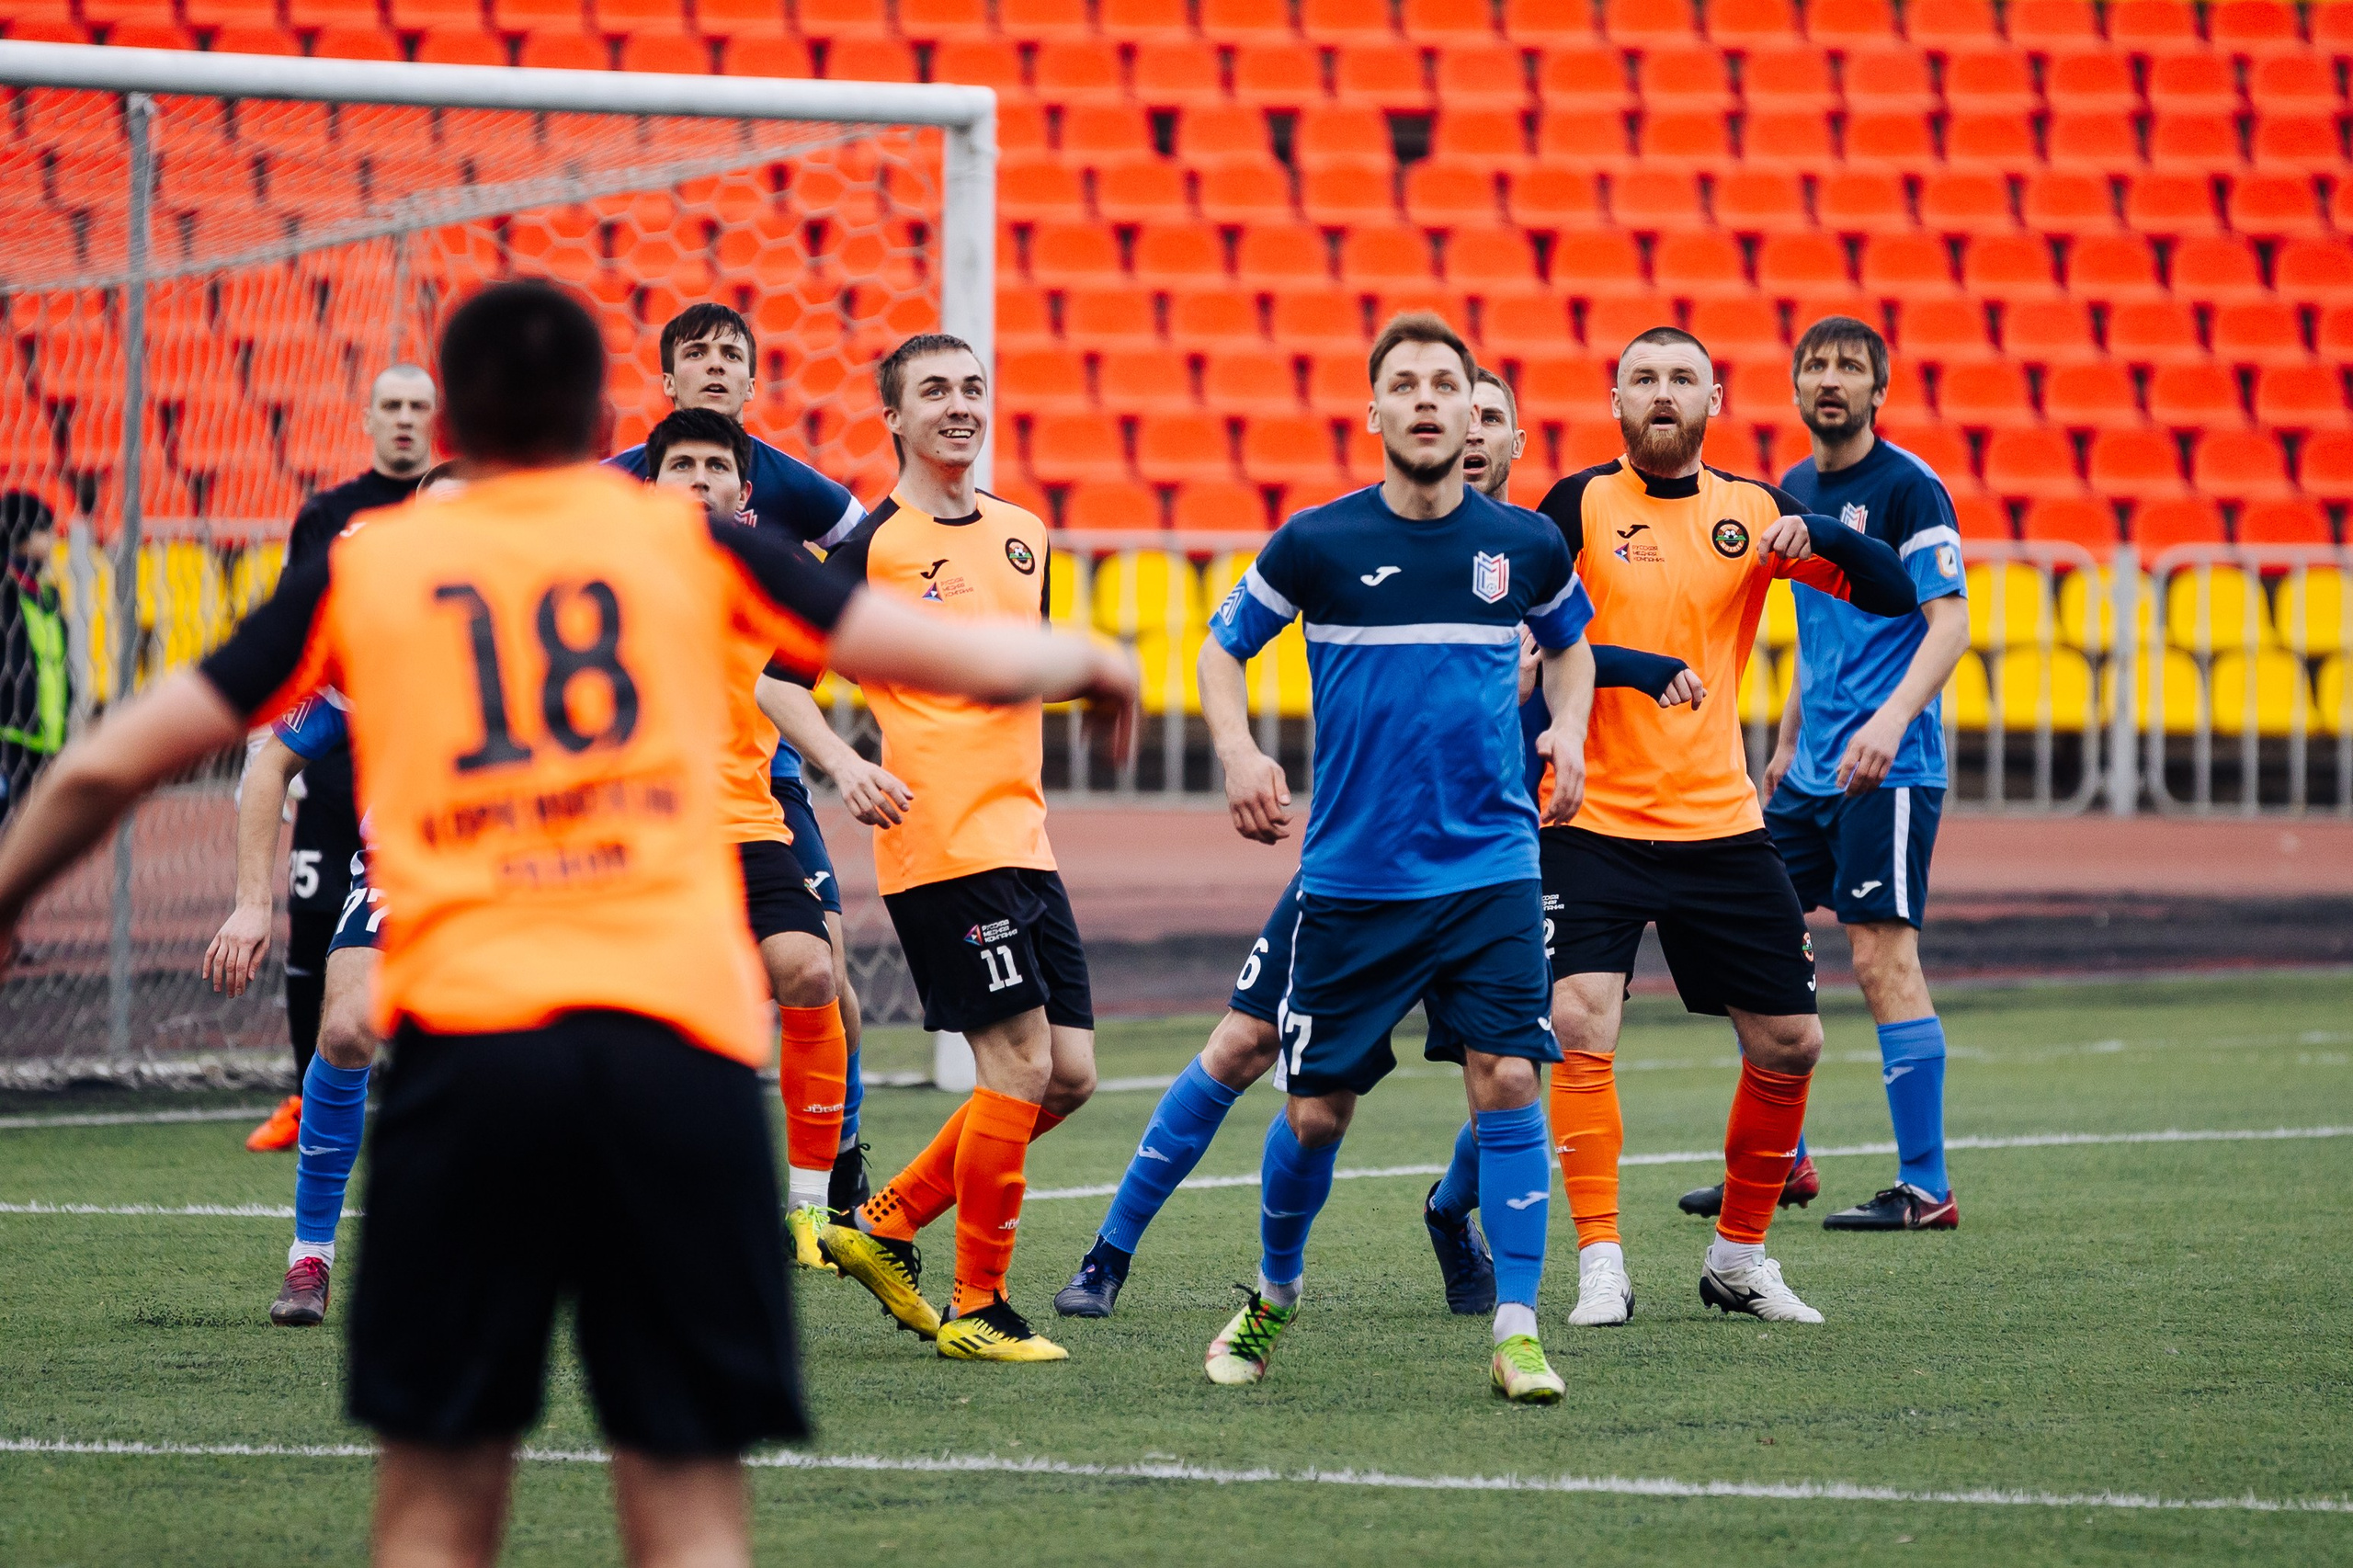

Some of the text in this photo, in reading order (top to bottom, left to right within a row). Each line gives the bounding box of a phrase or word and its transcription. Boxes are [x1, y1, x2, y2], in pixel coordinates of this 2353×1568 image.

[435, 581, 637, 772] 18
[980, 944, 1023, 993] 11
[1236, 937, 1268, 991] 6
[1285, 1010, 1313, 1076] 7
